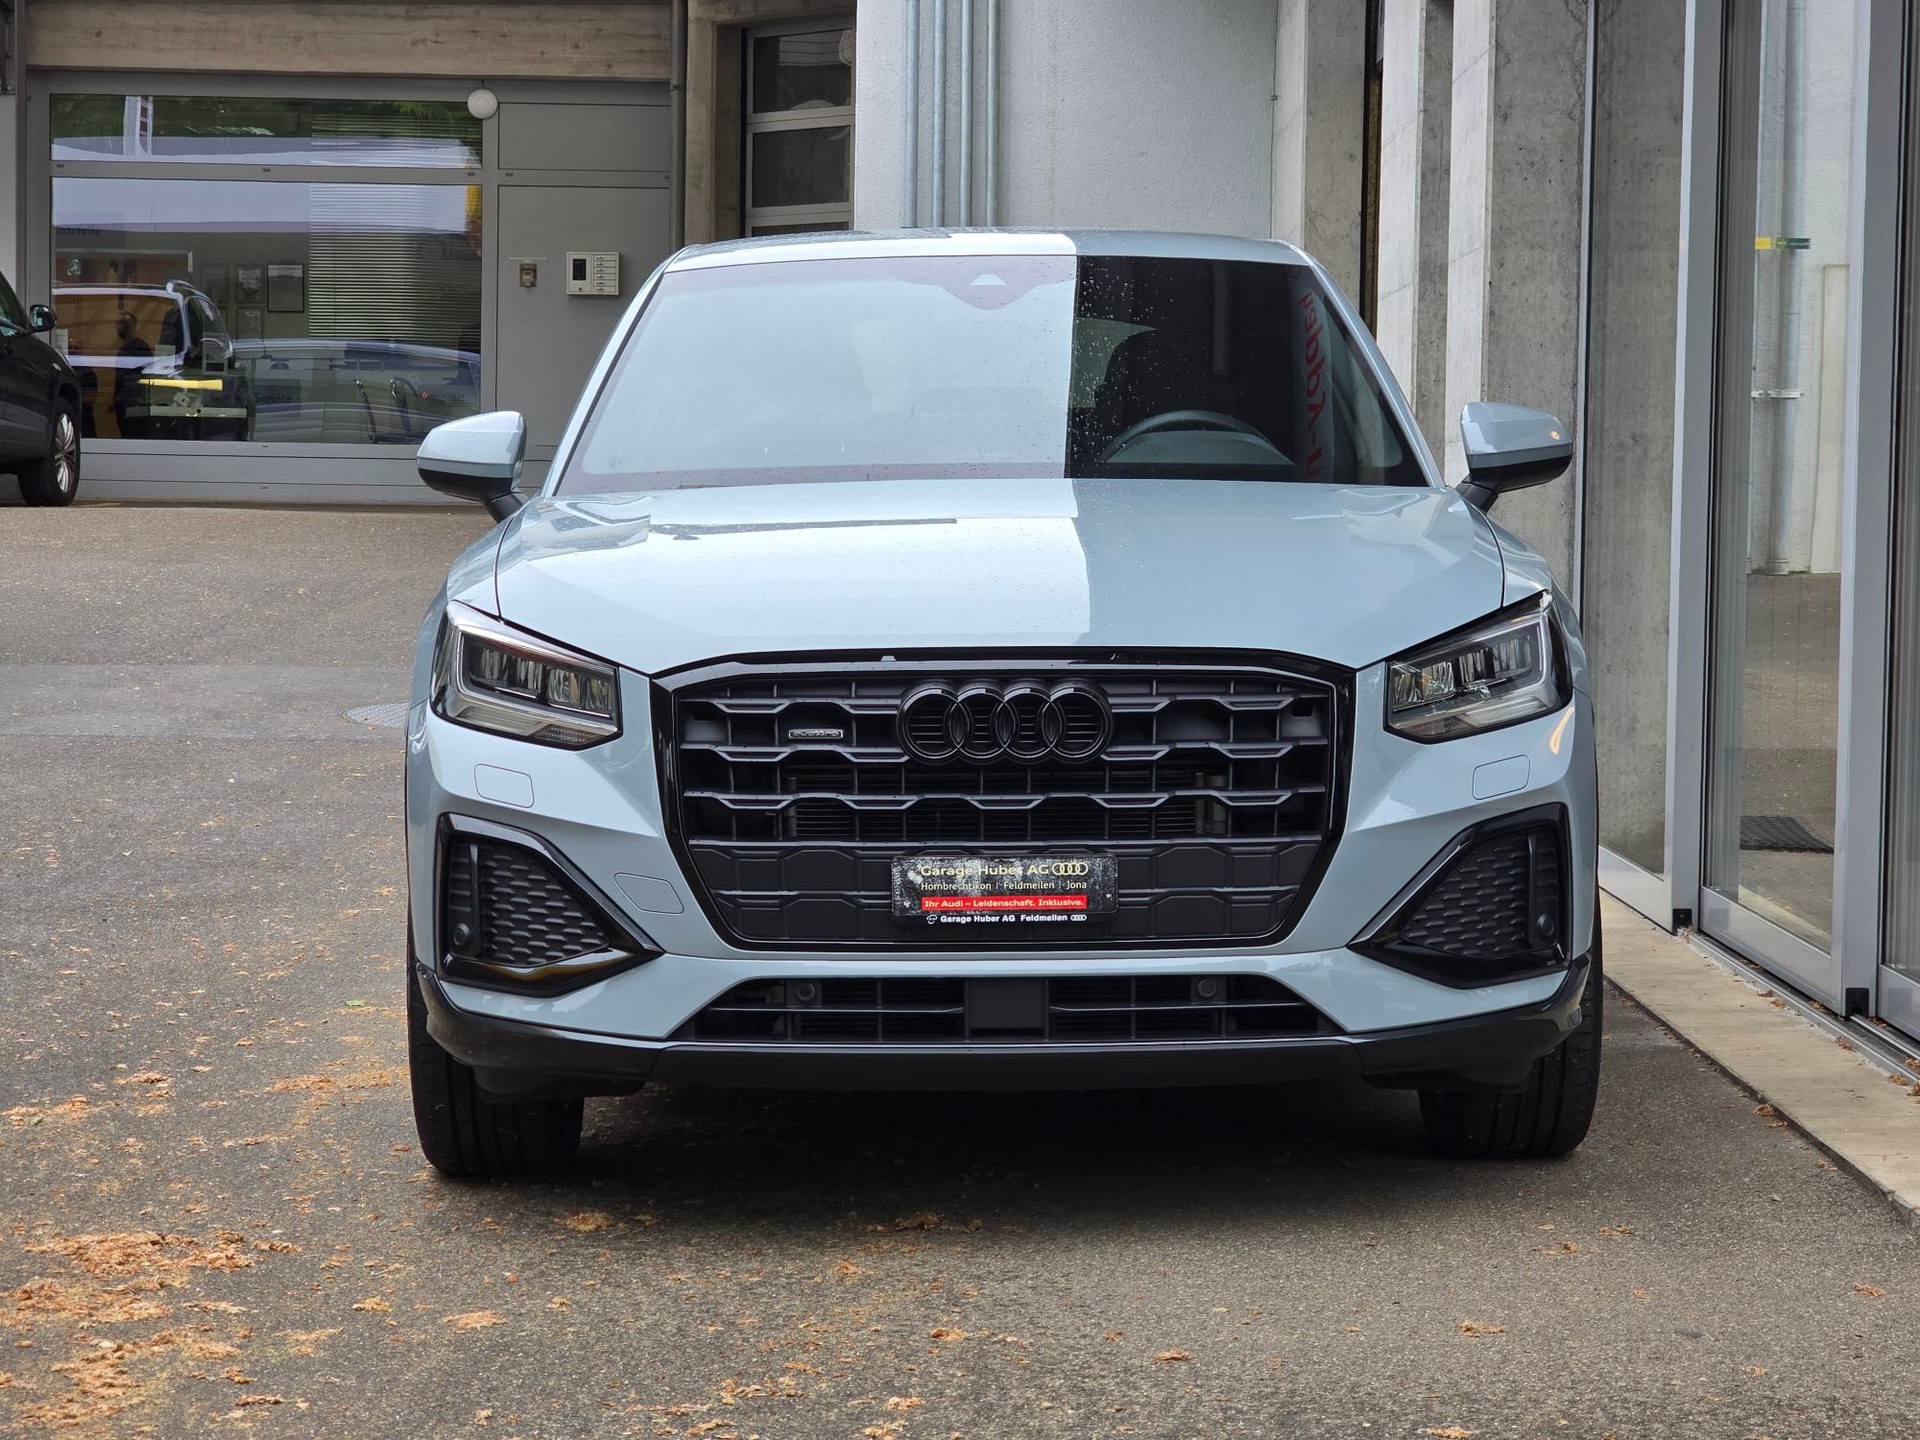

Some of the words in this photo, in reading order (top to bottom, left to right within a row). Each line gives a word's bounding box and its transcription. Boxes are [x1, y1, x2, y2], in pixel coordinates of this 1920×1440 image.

[920, 865, 973, 878] Garage
[1027, 864, 1049, 875] AG
[920, 881, 992, 891] Hombrechtikon
[1003, 880, 1055, 890] Feldmeilen
[1066, 880, 1087, 890] Jona
[924, 899, 939, 908] Ihr
[941, 899, 964, 908] Audi
[973, 898, 1036, 908] Leidenschaft.
[1037, 898, 1084, 907] Inklusive.
[940, 915, 972, 924] Garage
[973, 914, 1000, 923] Huber
[1001, 914, 1016, 922] AG
[1020, 913, 1068, 922] Feldmeilen
